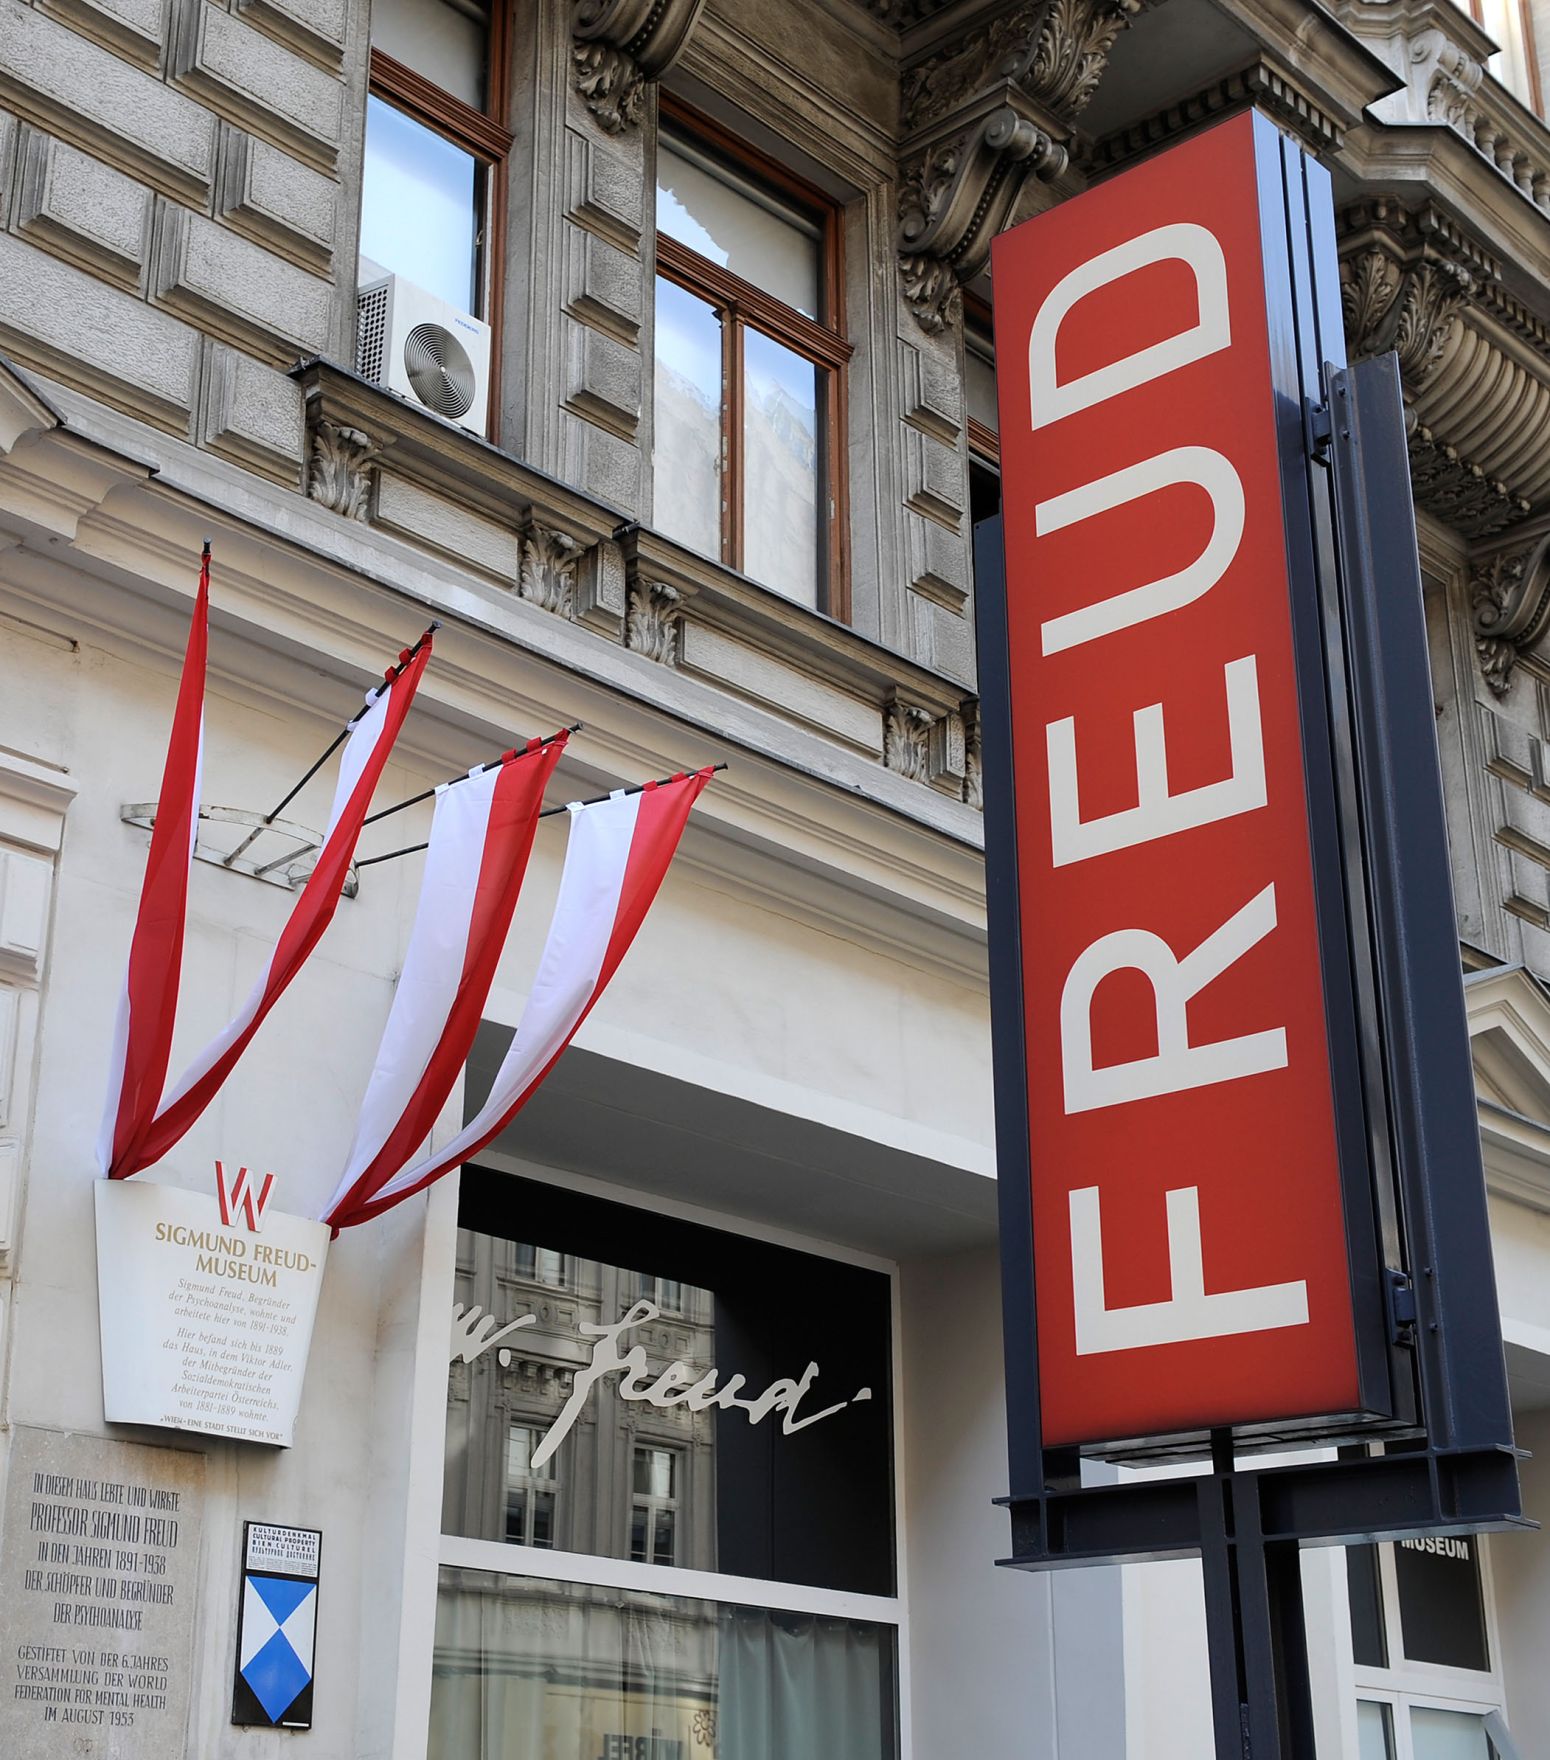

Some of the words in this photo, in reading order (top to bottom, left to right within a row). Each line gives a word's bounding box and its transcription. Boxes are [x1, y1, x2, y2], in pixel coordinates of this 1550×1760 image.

[1028, 222, 1309, 1356] FREUD
[215, 1160, 278, 1233] W
[155, 1223, 246, 1257] SIGMUND
[254, 1244, 316, 1272] FREUD-
[196, 1254, 277, 1287] MUSEUM
[178, 1279, 215, 1294] Sigmund
[248, 1293, 290, 1310] Begründer
[169, 1291, 183, 1300] der
[250, 1306, 277, 1320] wohnte
[281, 1313, 296, 1324] und
[175, 1307, 211, 1321] arbeitete
[214, 1312, 230, 1325] hier
[234, 1319, 246, 1328] von
[163, 1339, 178, 1350] das
[209, 1348, 218, 1358] in
[221, 1349, 238, 1361] dem
[241, 1352, 266, 1366] Viktor
[177, 1328, 195, 1339] Hier
[198, 1332, 226, 1345] befand
[230, 1339, 246, 1350] sich
[250, 1342, 262, 1352] bis
[265, 1345, 284, 1356] 1889
[182, 1357, 196, 1368] der
[199, 1359, 256, 1379] Mitbegründer
[258, 1371, 272, 1381] der
[171, 1383, 228, 1401] Arbeiterpartei
[181, 1370, 271, 1394] Sozialdemokratischen
[179, 1400, 192, 1408] von
[196, 1401, 236, 1416] 1881-1889
[188, 1418, 201, 1428] EINE
[205, 1422, 224, 1432] STADT
[249, 1428, 264, 1438] SICH
[34, 1473, 44, 1493] IN
[45, 1474, 73, 1497] DIESEM
[76, 1479, 98, 1500] HAUS
[100, 1483, 124, 1504] LEBTE
[127, 1486, 146, 1507] UND
[149, 1489, 180, 1512] WIRKTE
[30, 1502, 88, 1537] PROFESSOR
[90, 1510, 140, 1543] SIGMUND
[143, 1517, 178, 1548] FREUD
[253, 1527, 316, 1540] KULTURDENKMAL
[253, 1533, 282, 1542] CULTURAL
[285, 1537, 315, 1546] PROPERTY
[276, 1543, 315, 1553] CULTUREL
[1401, 1537, 1469, 1560] MUSEUM
[38, 1542, 48, 1562] IN
[51, 1542, 69, 1564] DEN
[72, 1545, 112, 1569] JAHREN
[115, 1551, 166, 1575] 1891-1938
[25, 1570, 43, 1591] DER
[44, 1572, 92, 1596] SCHÖPFER
[95, 1577, 116, 1599] UND
[120, 1580, 174, 1605] BEGRÜNDER
[54, 1602, 72, 1624] DER
[75, 1605, 143, 1631] PSYCHOANALYSE
[18, 1645, 67, 1663] GESTIFTET
[72, 1650, 95, 1665] VON
[100, 1653, 118, 1667] DER
[17, 1665, 98, 1685] VERSAMMLUNG
[104, 1672, 123, 1687] DER
[128, 1675, 167, 1690] WORLD
[15, 1685, 71, 1701] FEDERATION
[75, 1689, 91, 1705] FOR
[95, 1691, 129, 1707] MENTAL
[133, 1694, 166, 1709] HEALTH
[45, 1707, 57, 1721] IM
[62, 1709, 104, 1725] AUGUST
[110, 1711, 134, 1726] 1953
